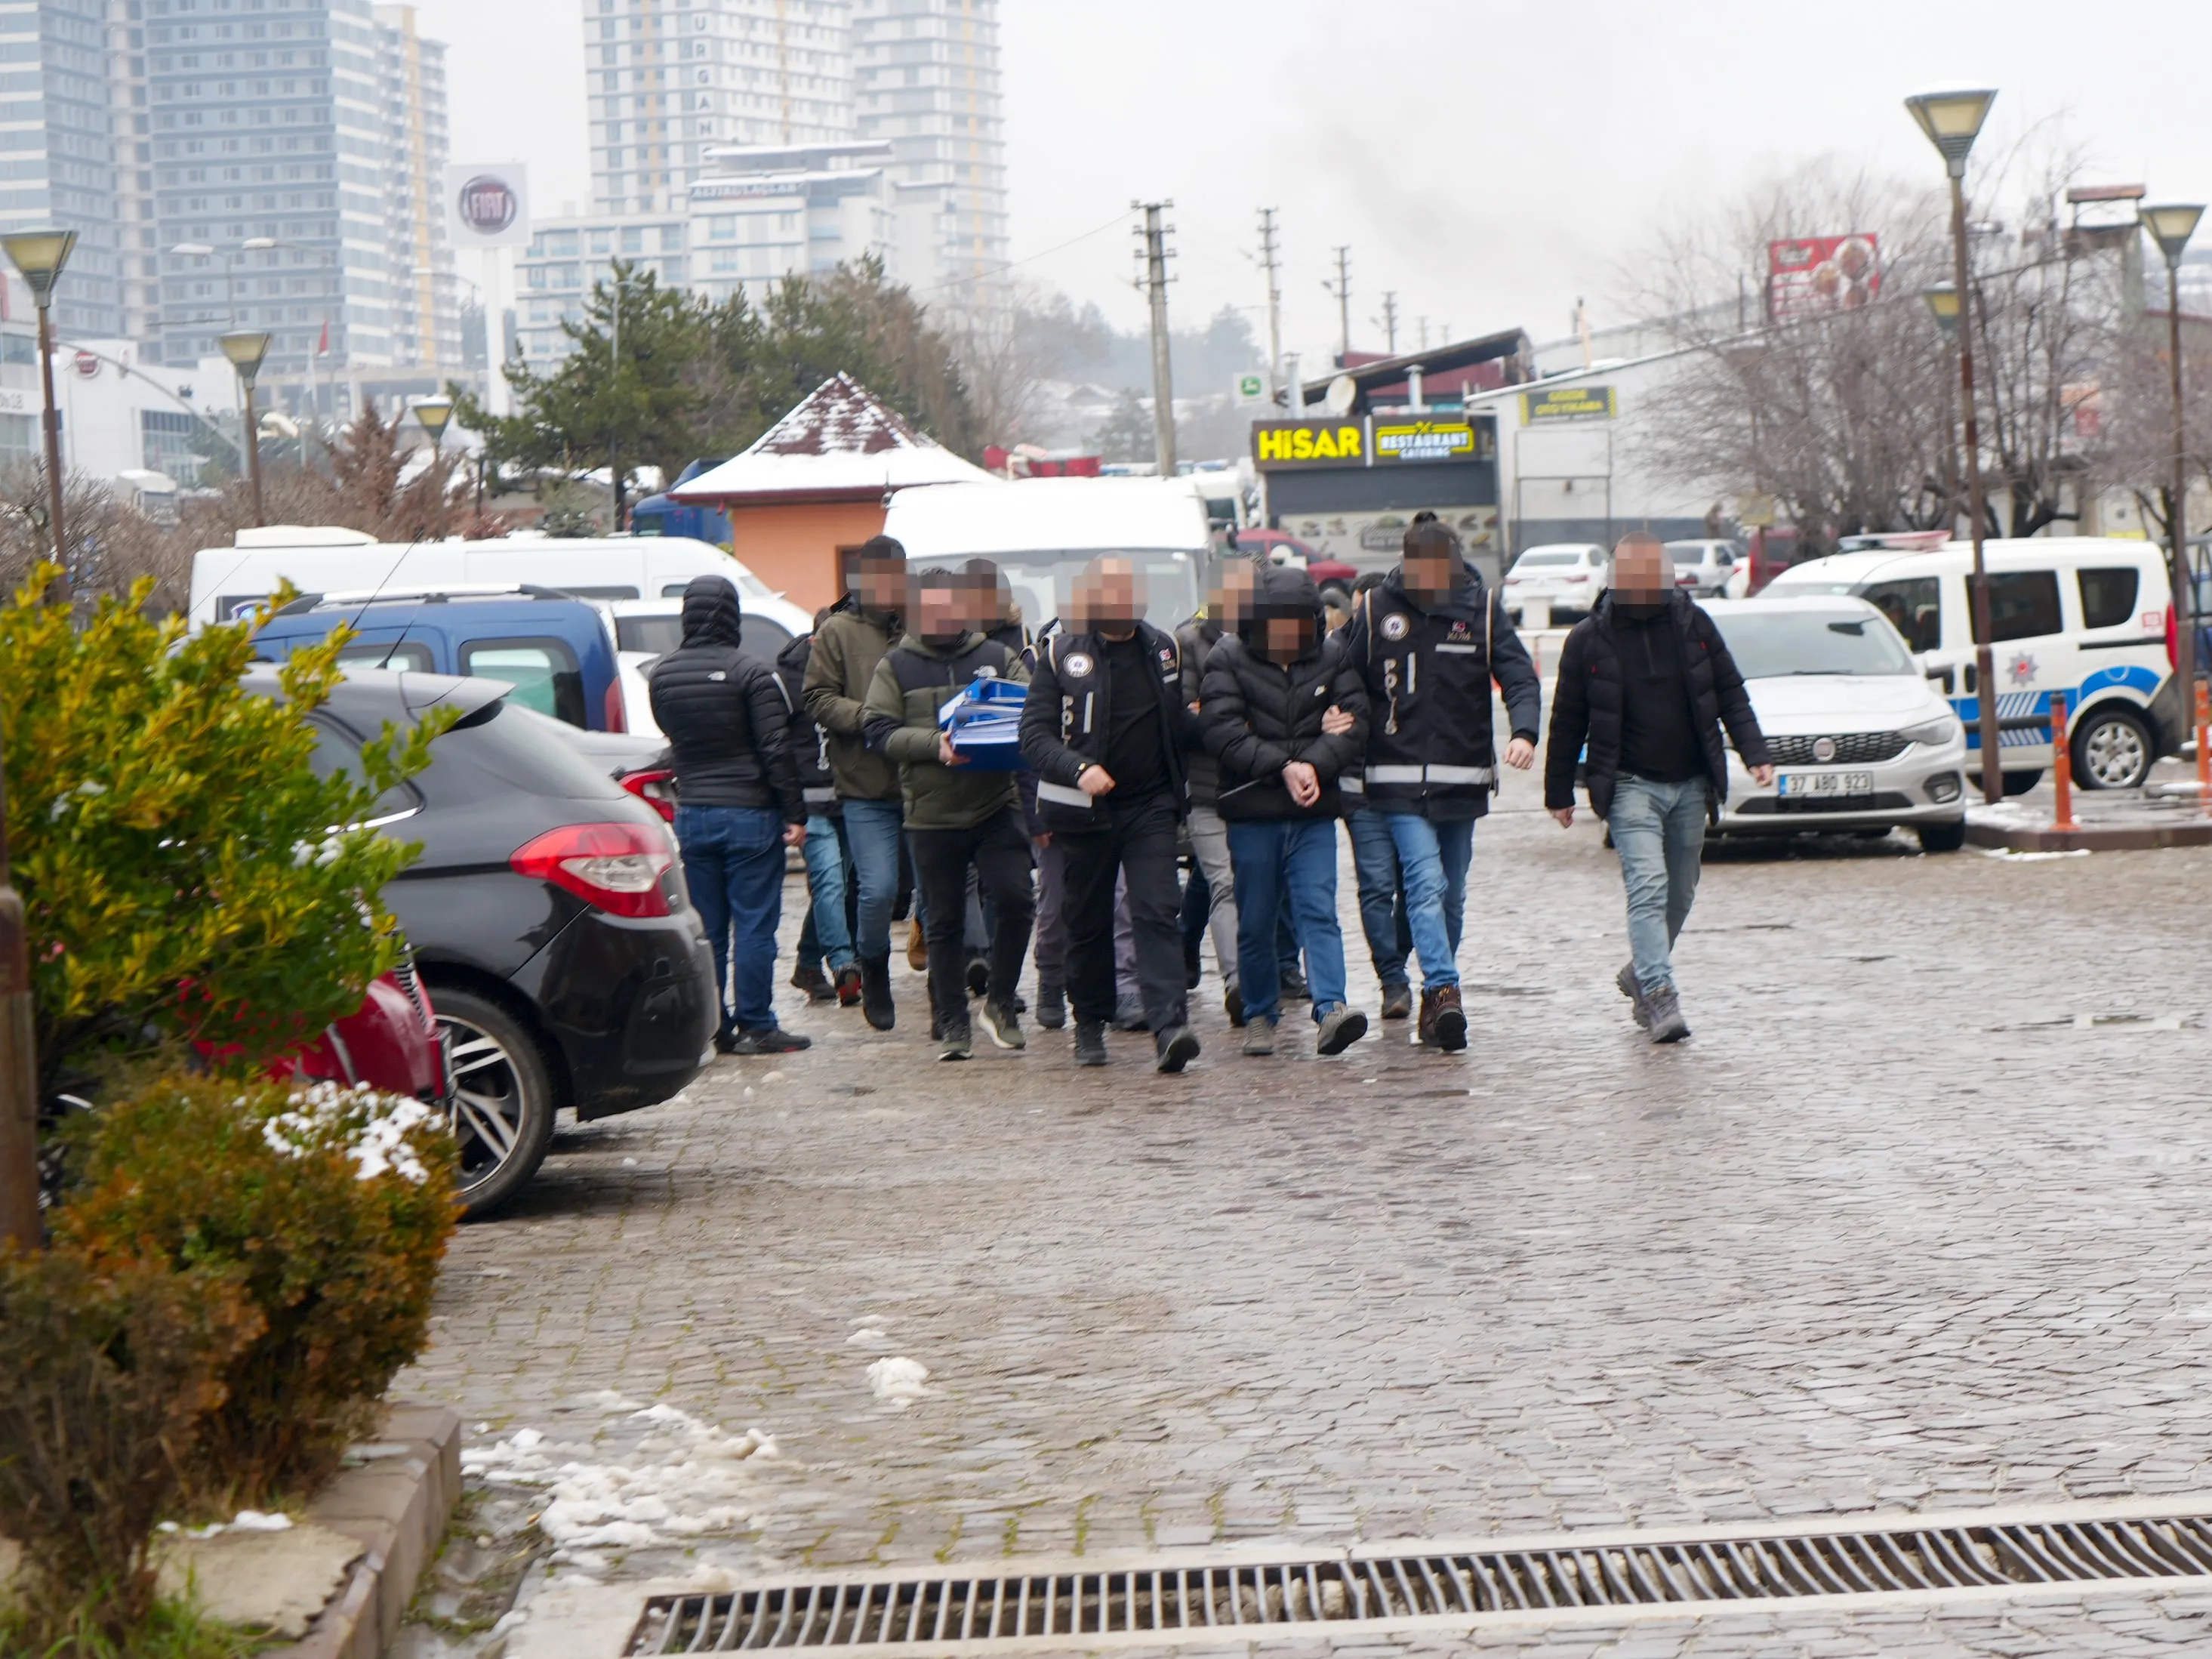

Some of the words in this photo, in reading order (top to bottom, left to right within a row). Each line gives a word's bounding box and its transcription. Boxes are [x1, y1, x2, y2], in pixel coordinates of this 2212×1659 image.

[470, 191, 505, 220] FIAT
[1380, 432, 1468, 450] RESTAURANT
[1789, 776, 1807, 791] 37
[1844, 773, 1868, 789] 923
